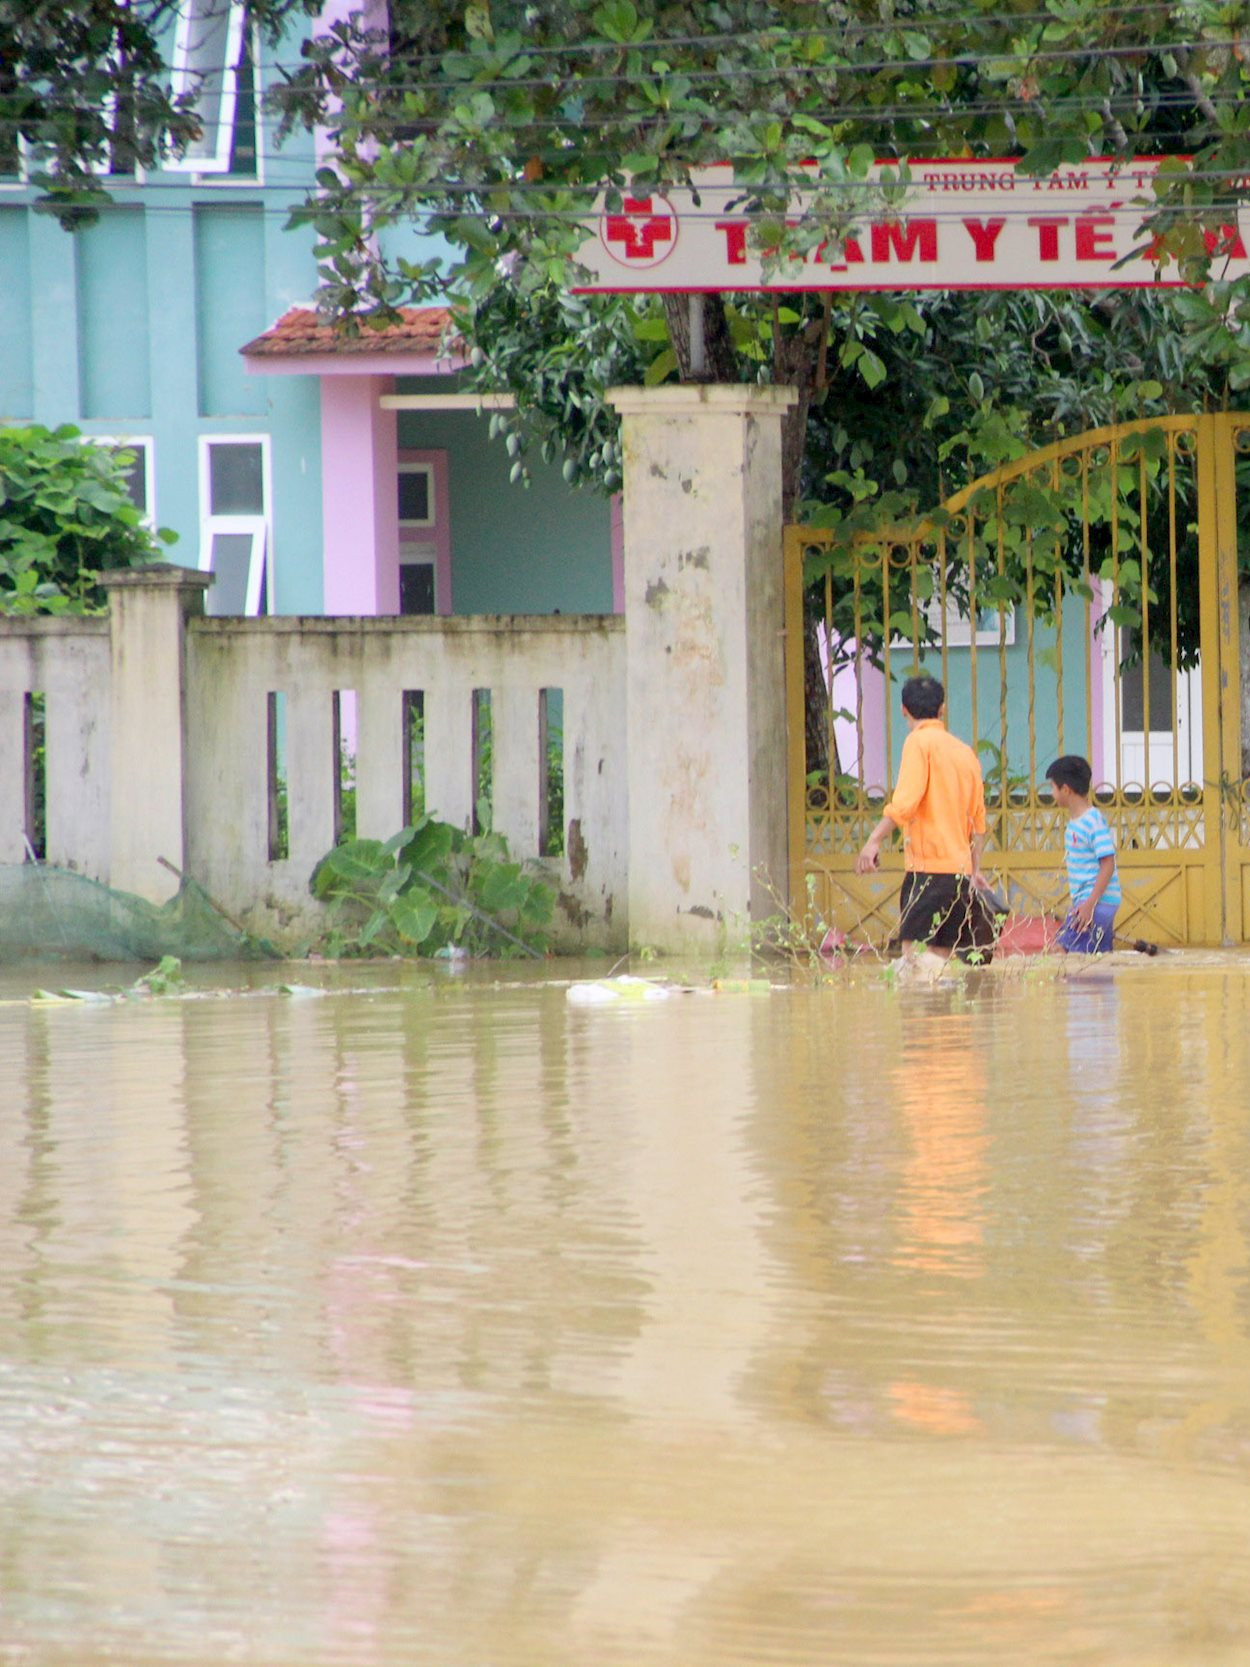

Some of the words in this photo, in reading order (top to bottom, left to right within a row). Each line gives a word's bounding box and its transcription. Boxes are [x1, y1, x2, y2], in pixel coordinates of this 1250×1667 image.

[923, 172, 1015, 192] TRUNG
[961, 217, 1007, 262] Y
[1027, 201, 1118, 261] TẾ
